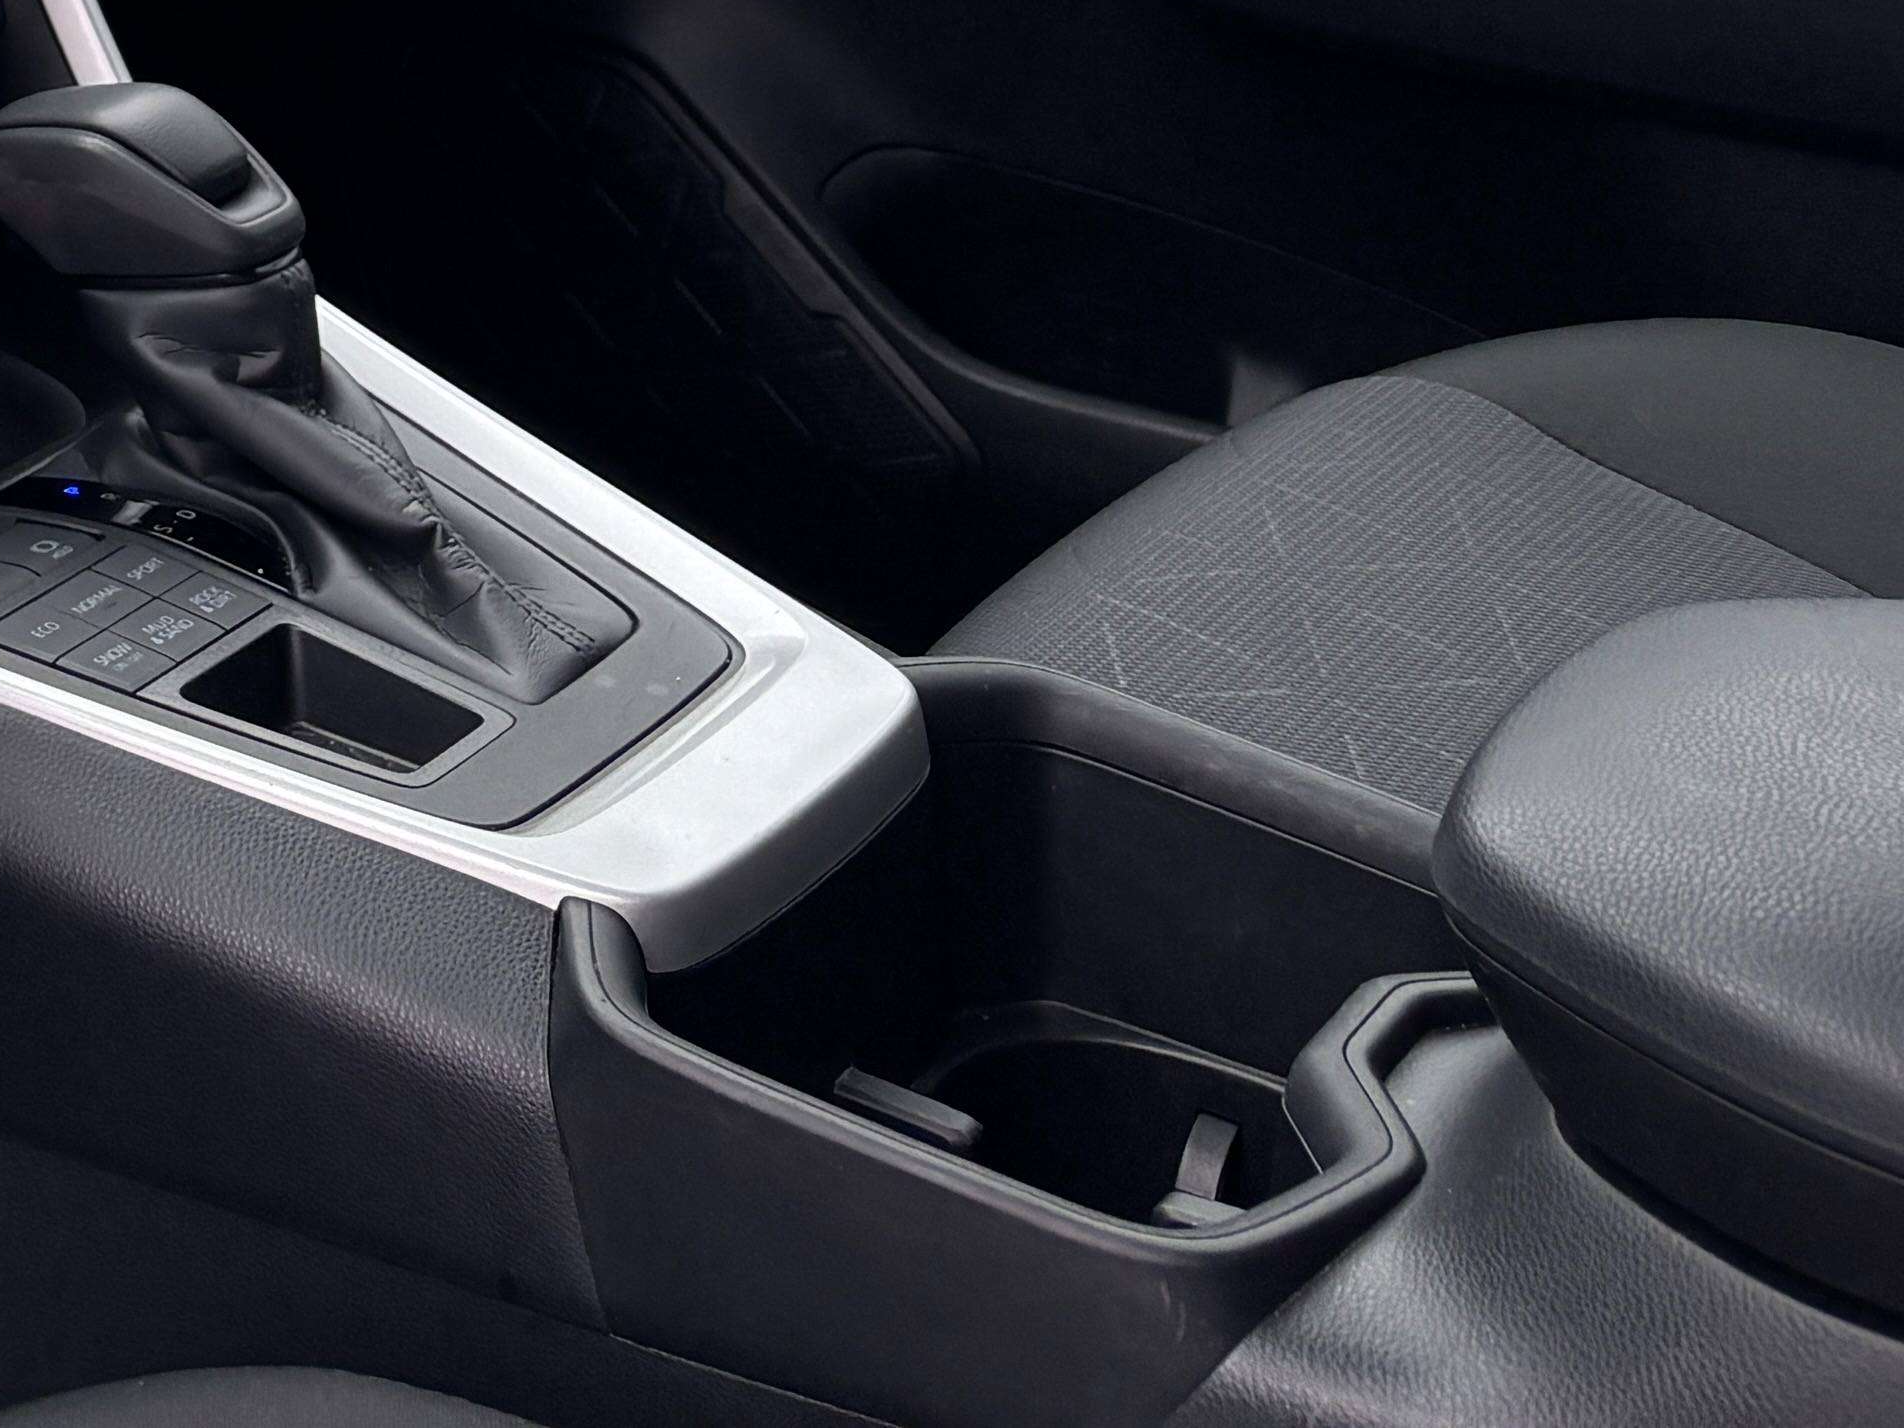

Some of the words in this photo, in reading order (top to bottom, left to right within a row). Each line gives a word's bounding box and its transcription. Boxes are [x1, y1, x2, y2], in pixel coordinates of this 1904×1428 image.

[127, 556, 164, 581] SPORT
[71, 584, 123, 614] NORMAL
[30, 622, 60, 639] ECO
[142, 615, 174, 635] MUD
[158, 619, 194, 639] SAND
[93, 642, 133, 667] SNOW
